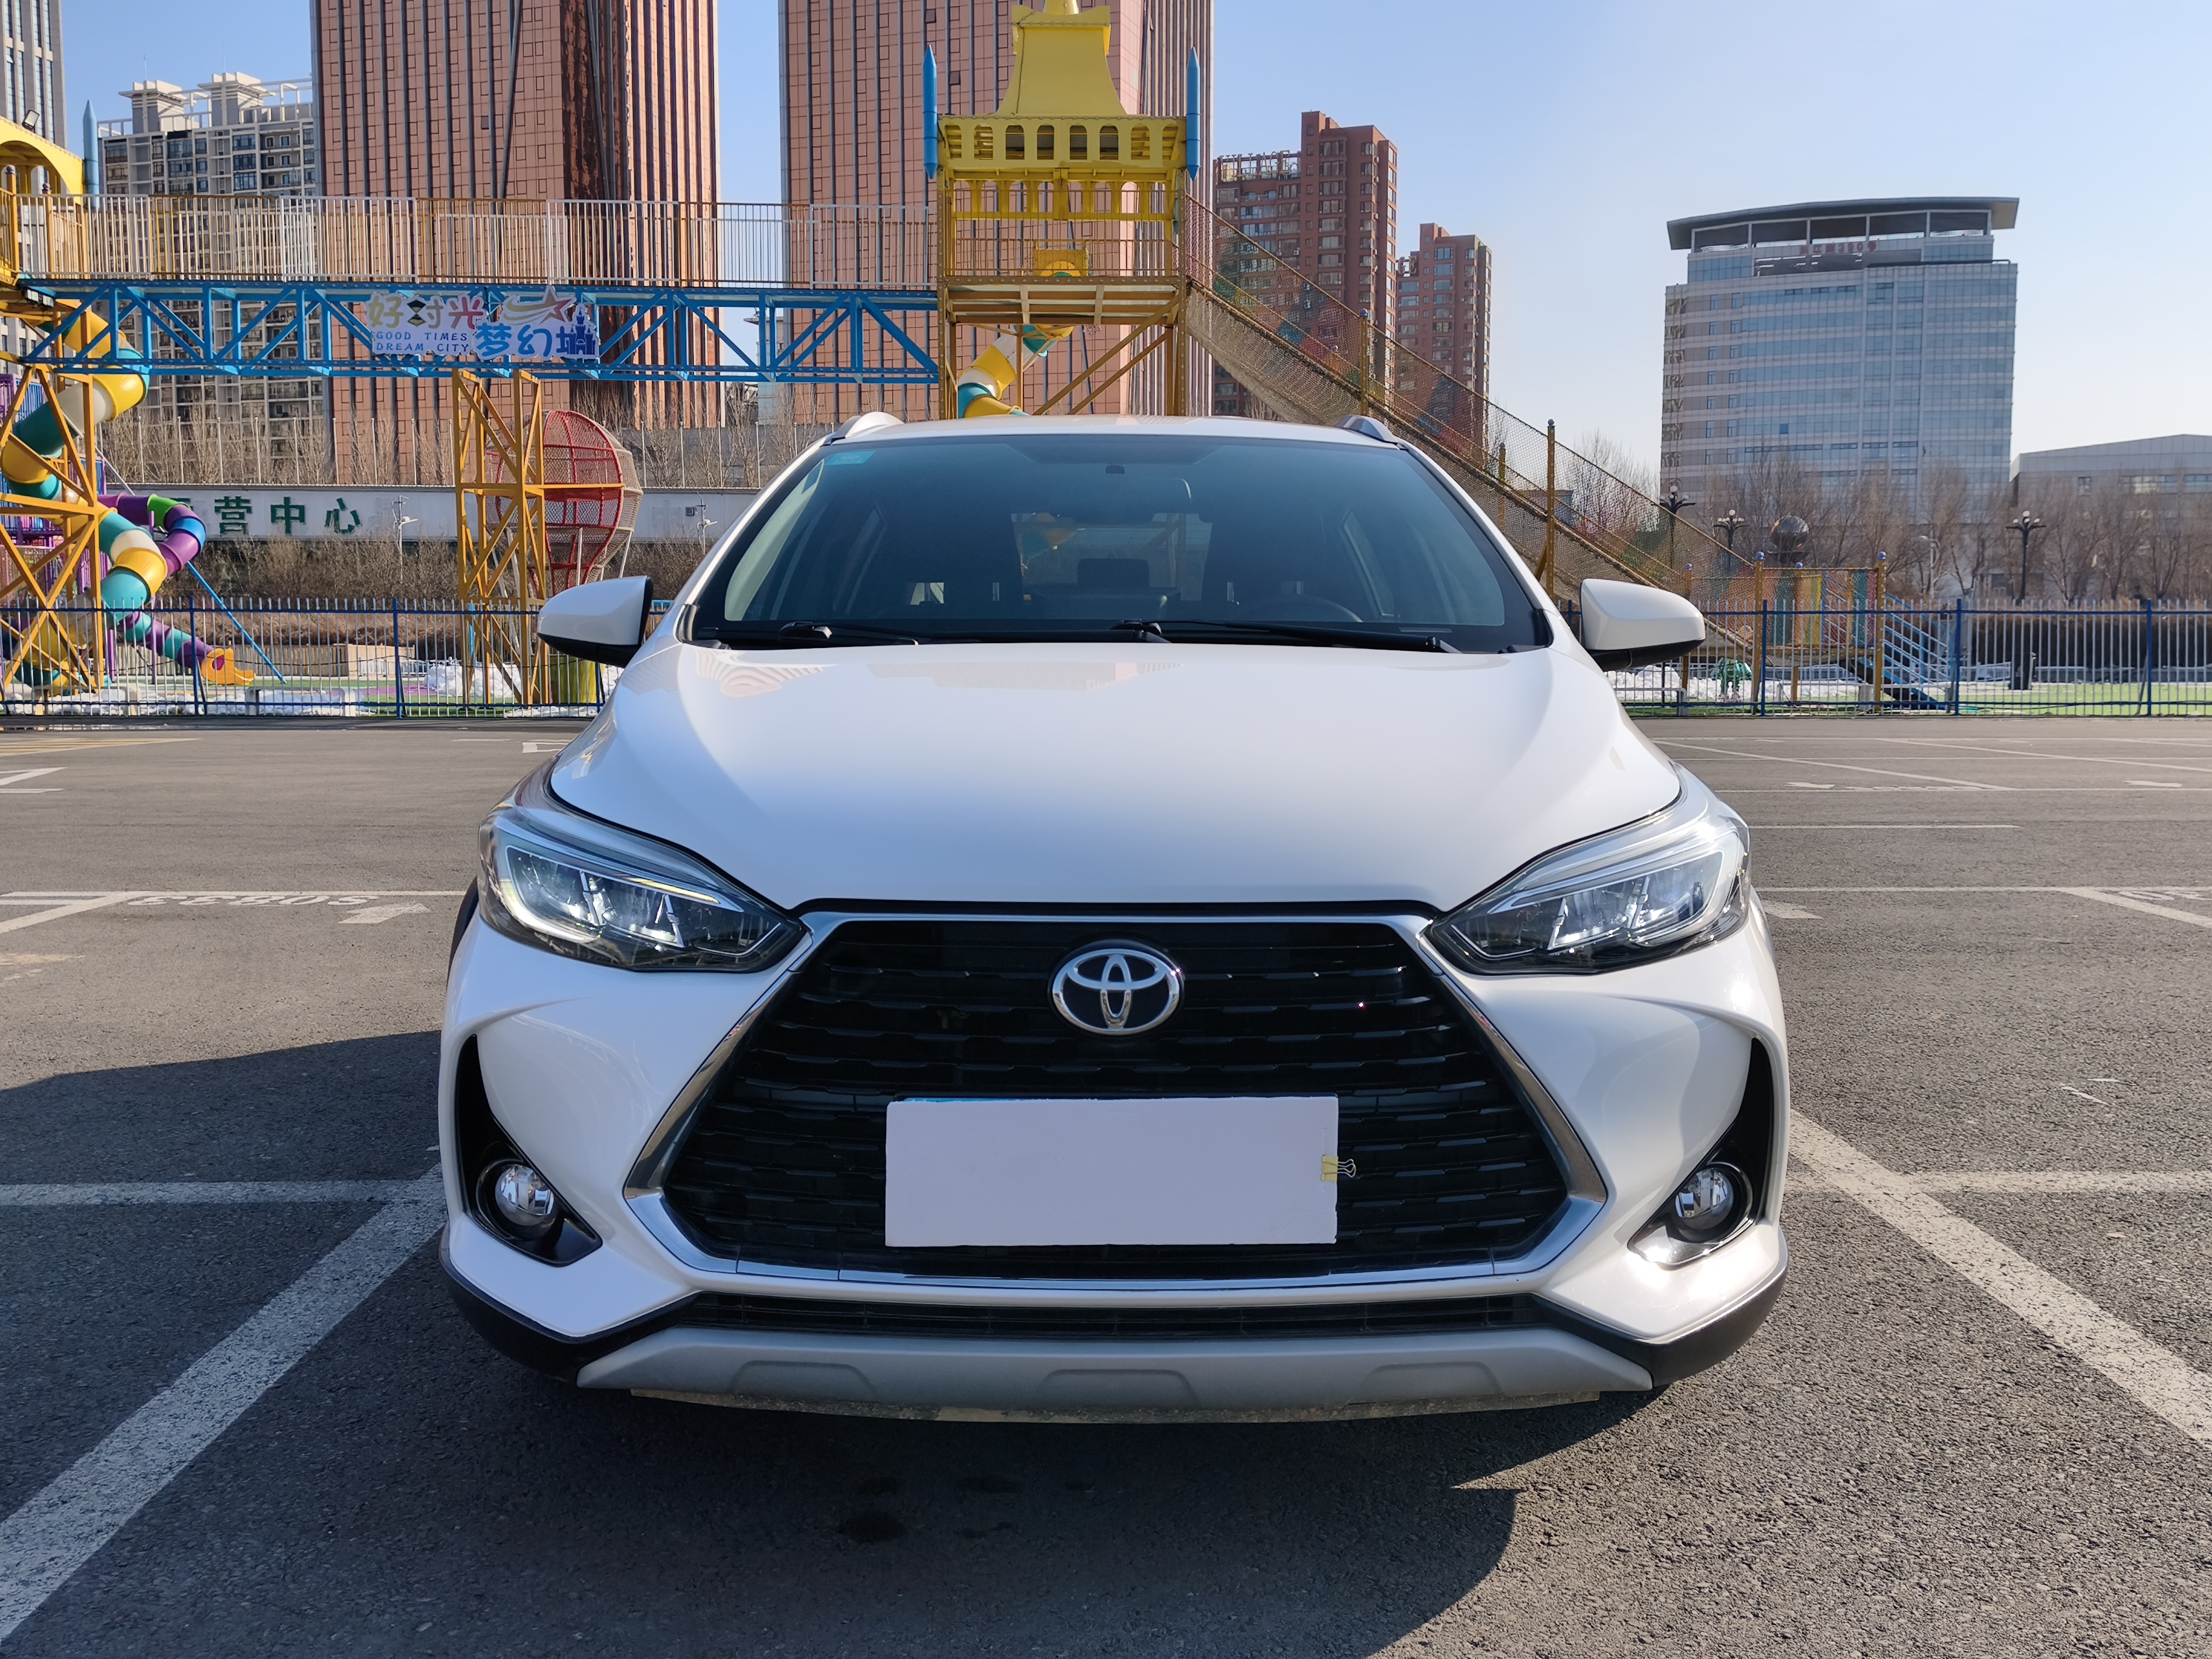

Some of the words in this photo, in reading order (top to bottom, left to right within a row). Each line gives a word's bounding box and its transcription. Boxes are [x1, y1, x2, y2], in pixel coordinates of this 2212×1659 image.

[369, 297, 484, 329] 好时光
[376, 332, 411, 340] GOOD
[424, 333, 467, 341] TIMES
[376, 343, 423, 351] DREAM
[437, 343, 469, 352] CITY
[170, 496, 362, 535] 营中心
